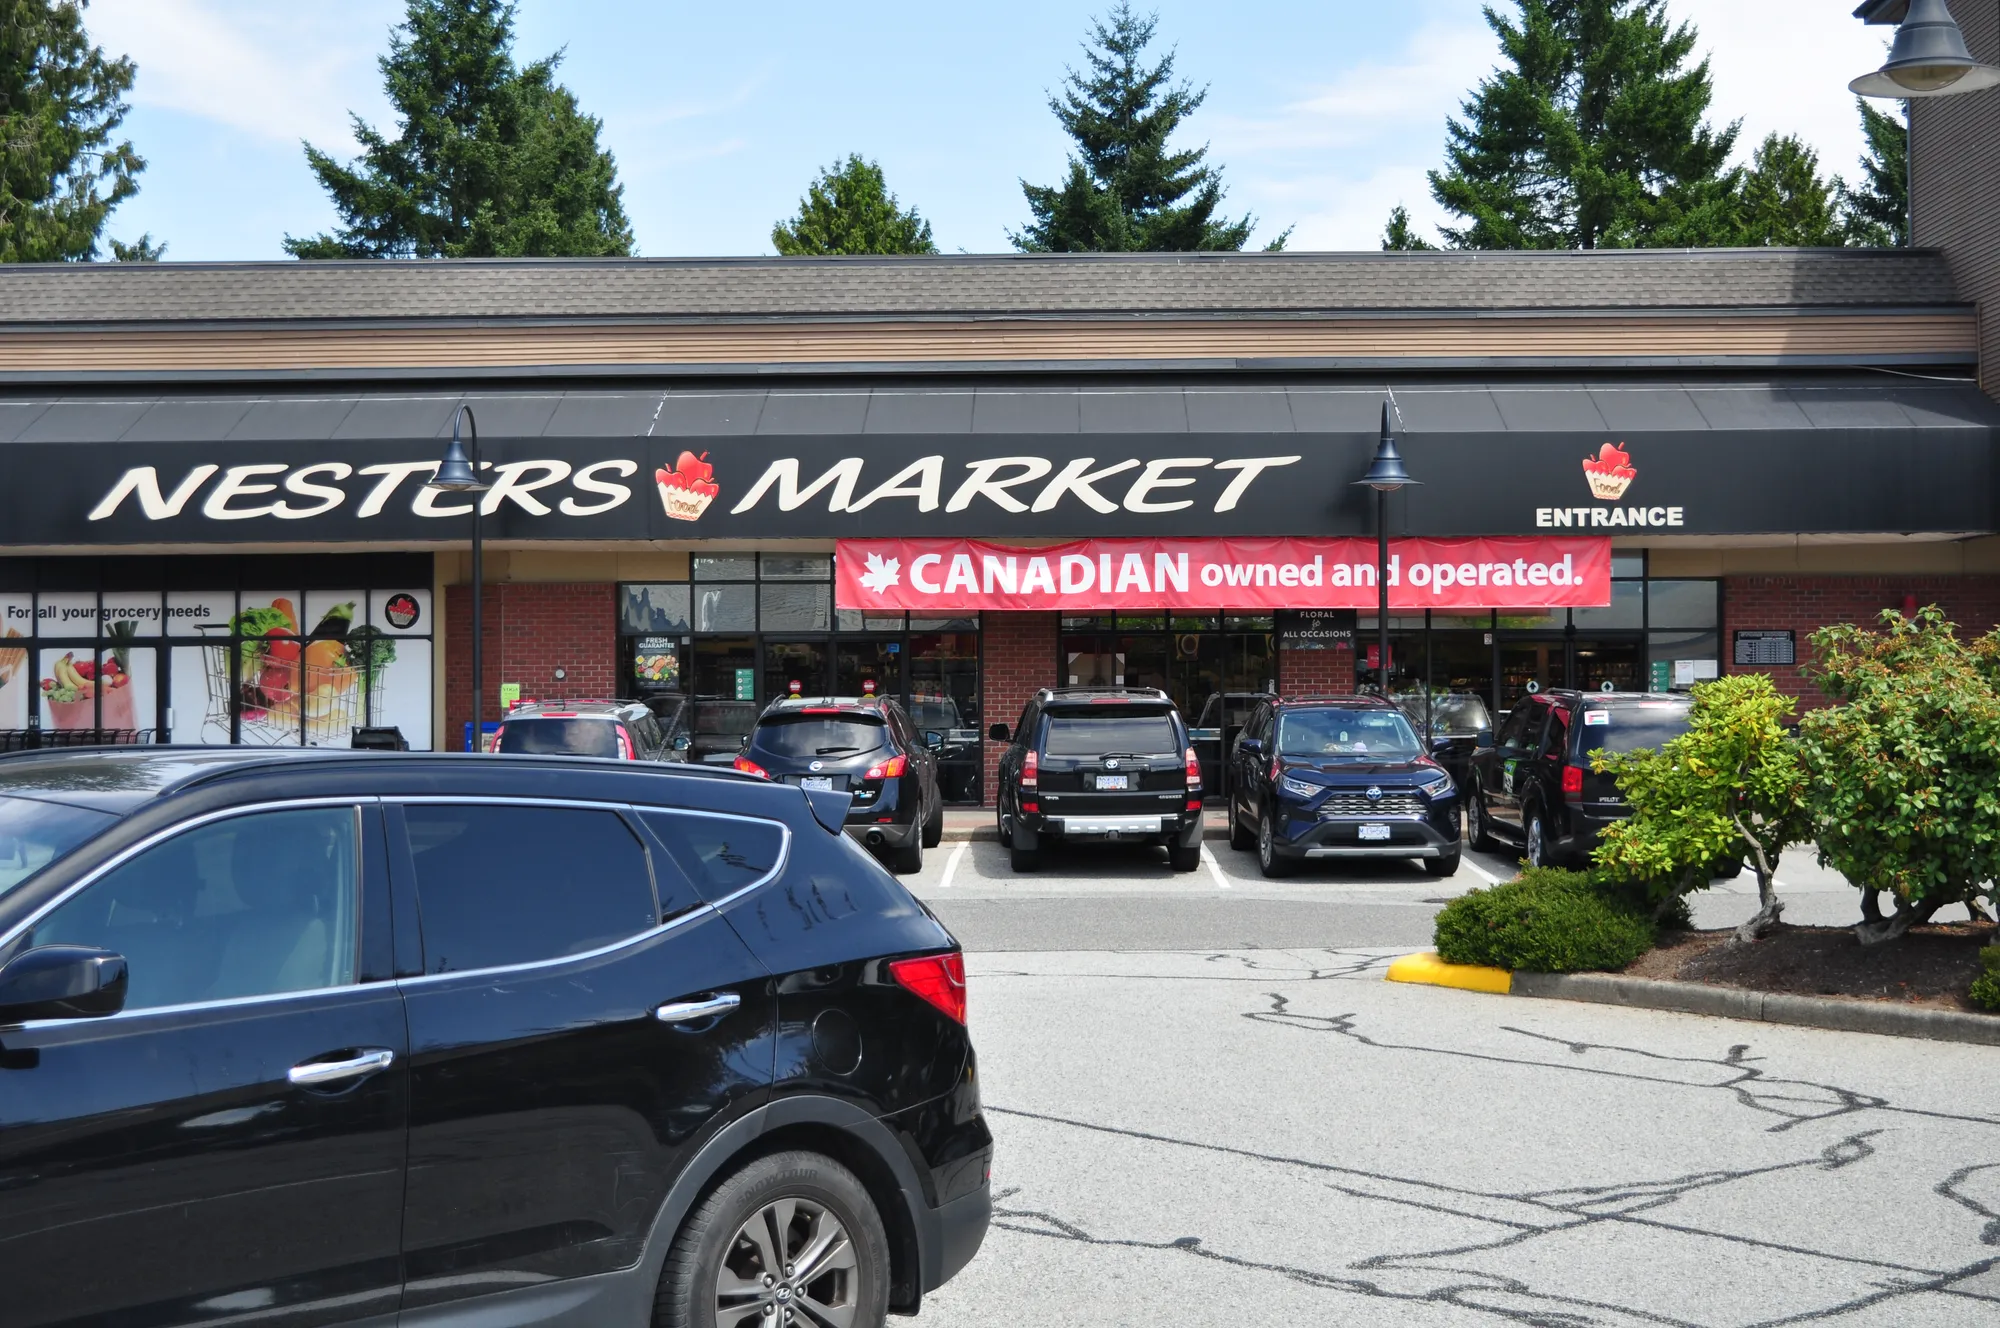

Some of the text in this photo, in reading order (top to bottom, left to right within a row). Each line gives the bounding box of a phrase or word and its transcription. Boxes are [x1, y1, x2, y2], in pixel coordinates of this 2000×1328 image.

[89, 459, 639, 521] NESTERS
[731, 456, 1303, 515] MARKET
[1594, 478, 1622, 494] Food
[667, 492, 702, 514] Food
[1536, 507, 1684, 527] ENTRANCE
[910, 553, 1584, 595] CANADIAN owned and operated.
[8, 605, 210, 621] For all your grocery needs
[1300, 630, 1352, 638] OCCASIONS
